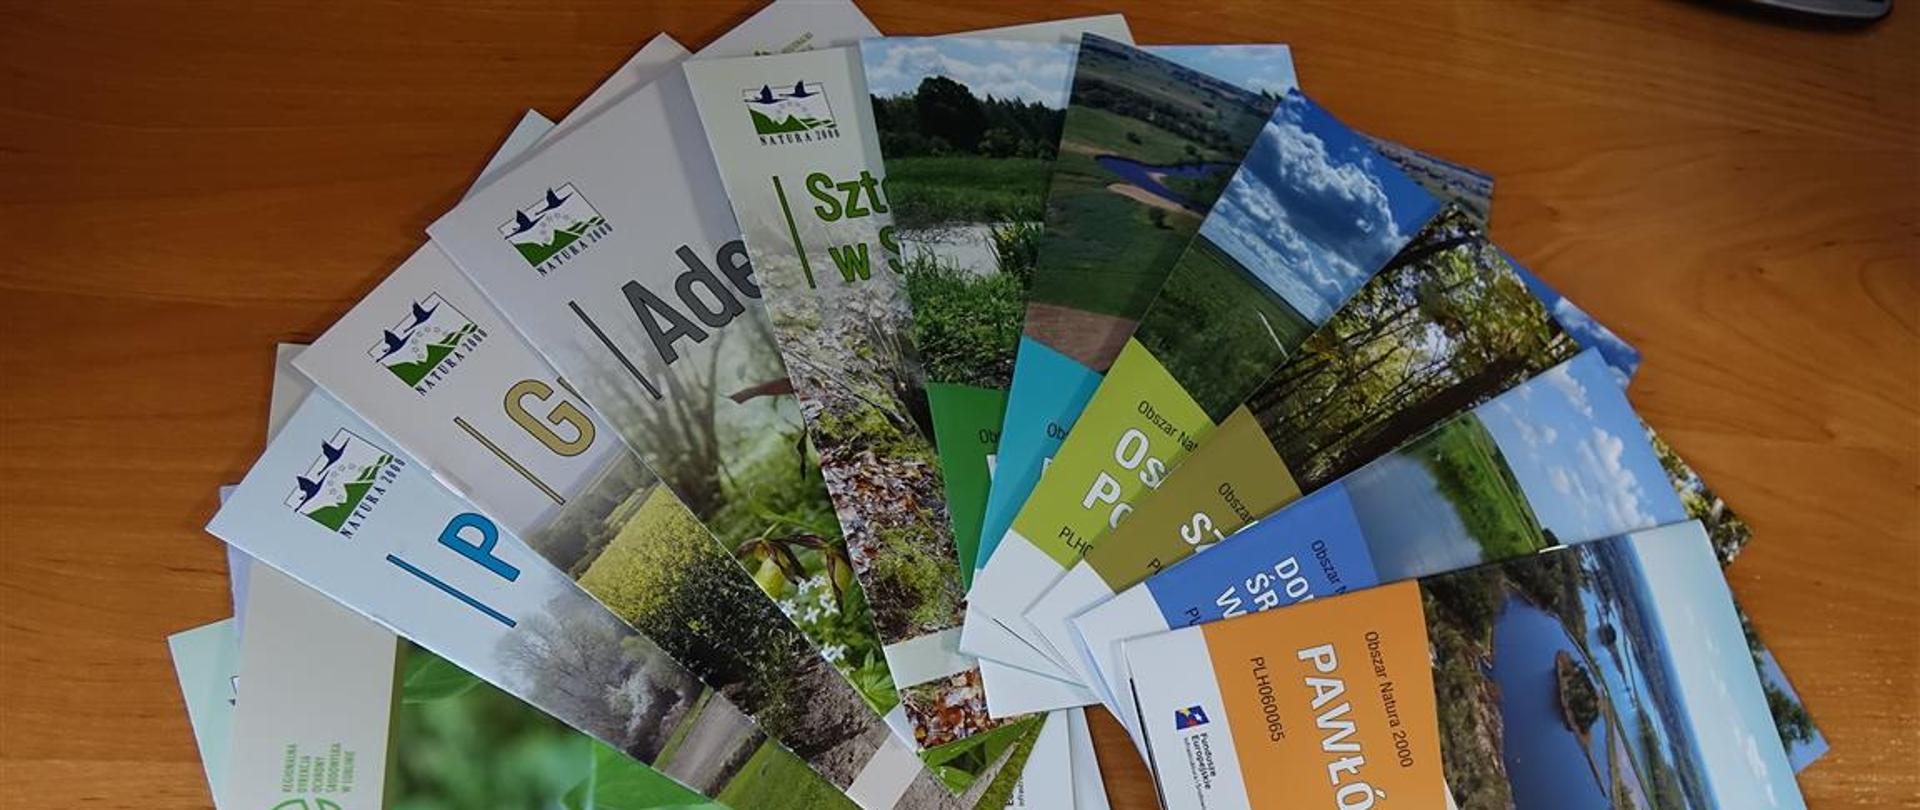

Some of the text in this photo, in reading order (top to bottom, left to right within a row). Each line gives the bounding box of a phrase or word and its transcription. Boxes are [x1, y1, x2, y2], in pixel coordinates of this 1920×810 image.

[759, 128, 840, 146] NATURA 2000
[805, 170, 889, 222] Szt
[536, 221, 613, 276] NATURA 2000
[415, 328, 489, 397] NATURA 2000
[503, 376, 596, 457] G
[1137, 400, 1178, 437] Obszar
[340, 457, 406, 539] NATURA 2000
[437, 511, 521, 583] P
[1311, 539, 1341, 585] Obszar
[1249, 656, 1286, 743] PLH060065
[1364, 631, 1414, 768] Obszar Natura 2000
[1200, 732, 1217, 777] Fundusze
